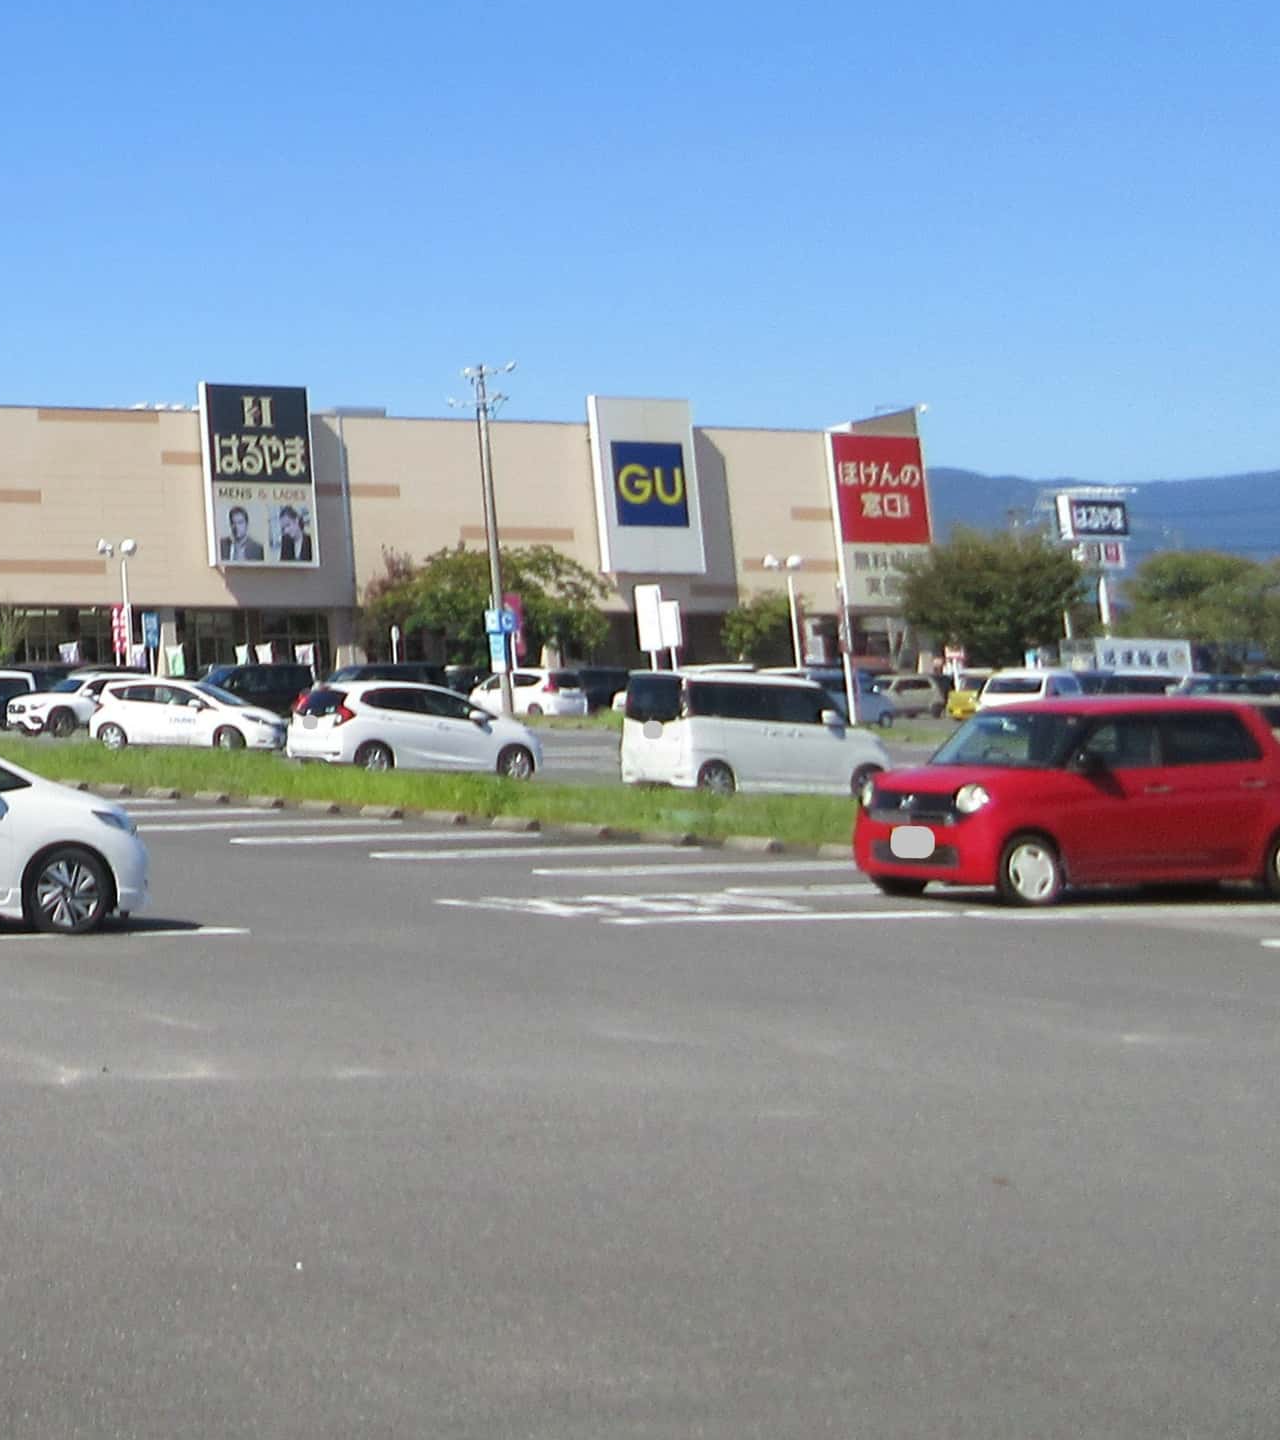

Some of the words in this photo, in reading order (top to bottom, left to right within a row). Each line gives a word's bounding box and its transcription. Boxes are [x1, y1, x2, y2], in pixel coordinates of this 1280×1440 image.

[214, 434, 306, 476] はるやま
[838, 461, 921, 488] ほけんの
[617, 463, 684, 505] GU
